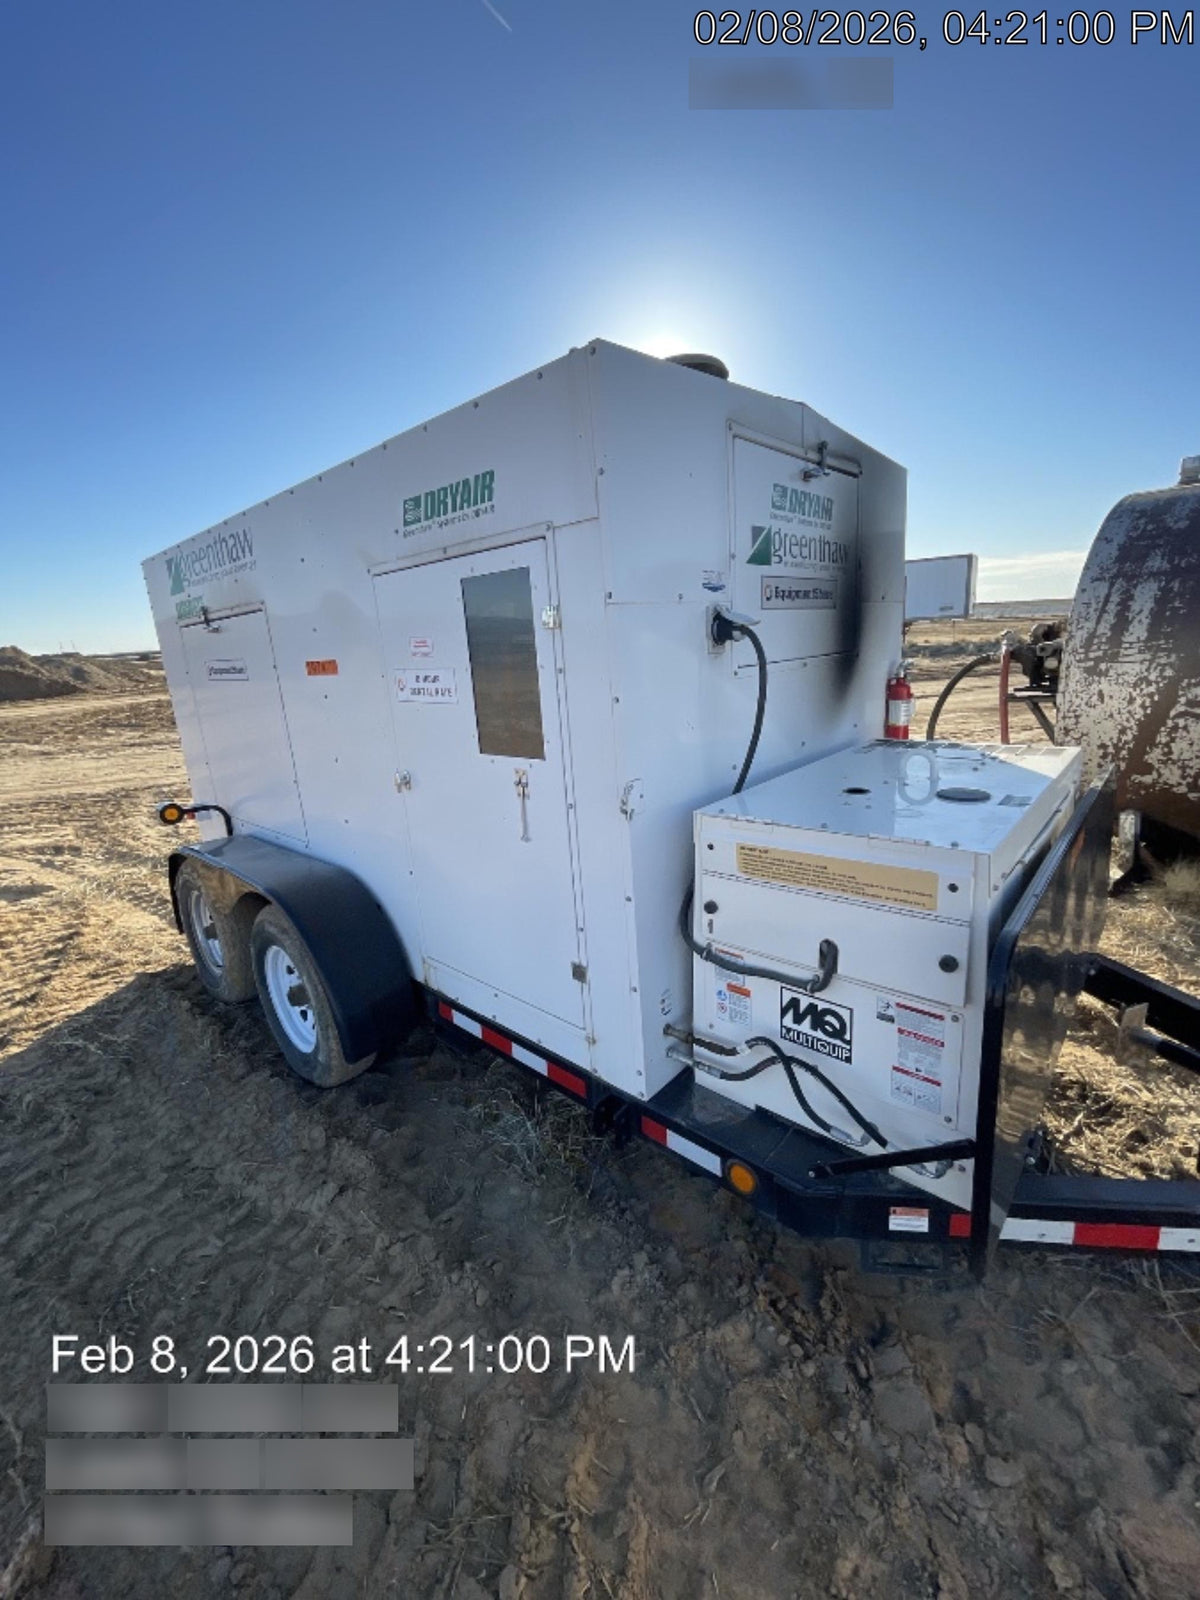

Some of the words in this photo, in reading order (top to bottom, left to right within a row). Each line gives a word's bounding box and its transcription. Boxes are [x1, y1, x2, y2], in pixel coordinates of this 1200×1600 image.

[423, 469, 494, 522] DRYAIR
[787, 486, 833, 522] DRYAIR
[772, 528, 850, 565] greenthaw
[782, 996, 851, 1046] MQ
[782, 1027, 850, 1061] MULTIQUIP
